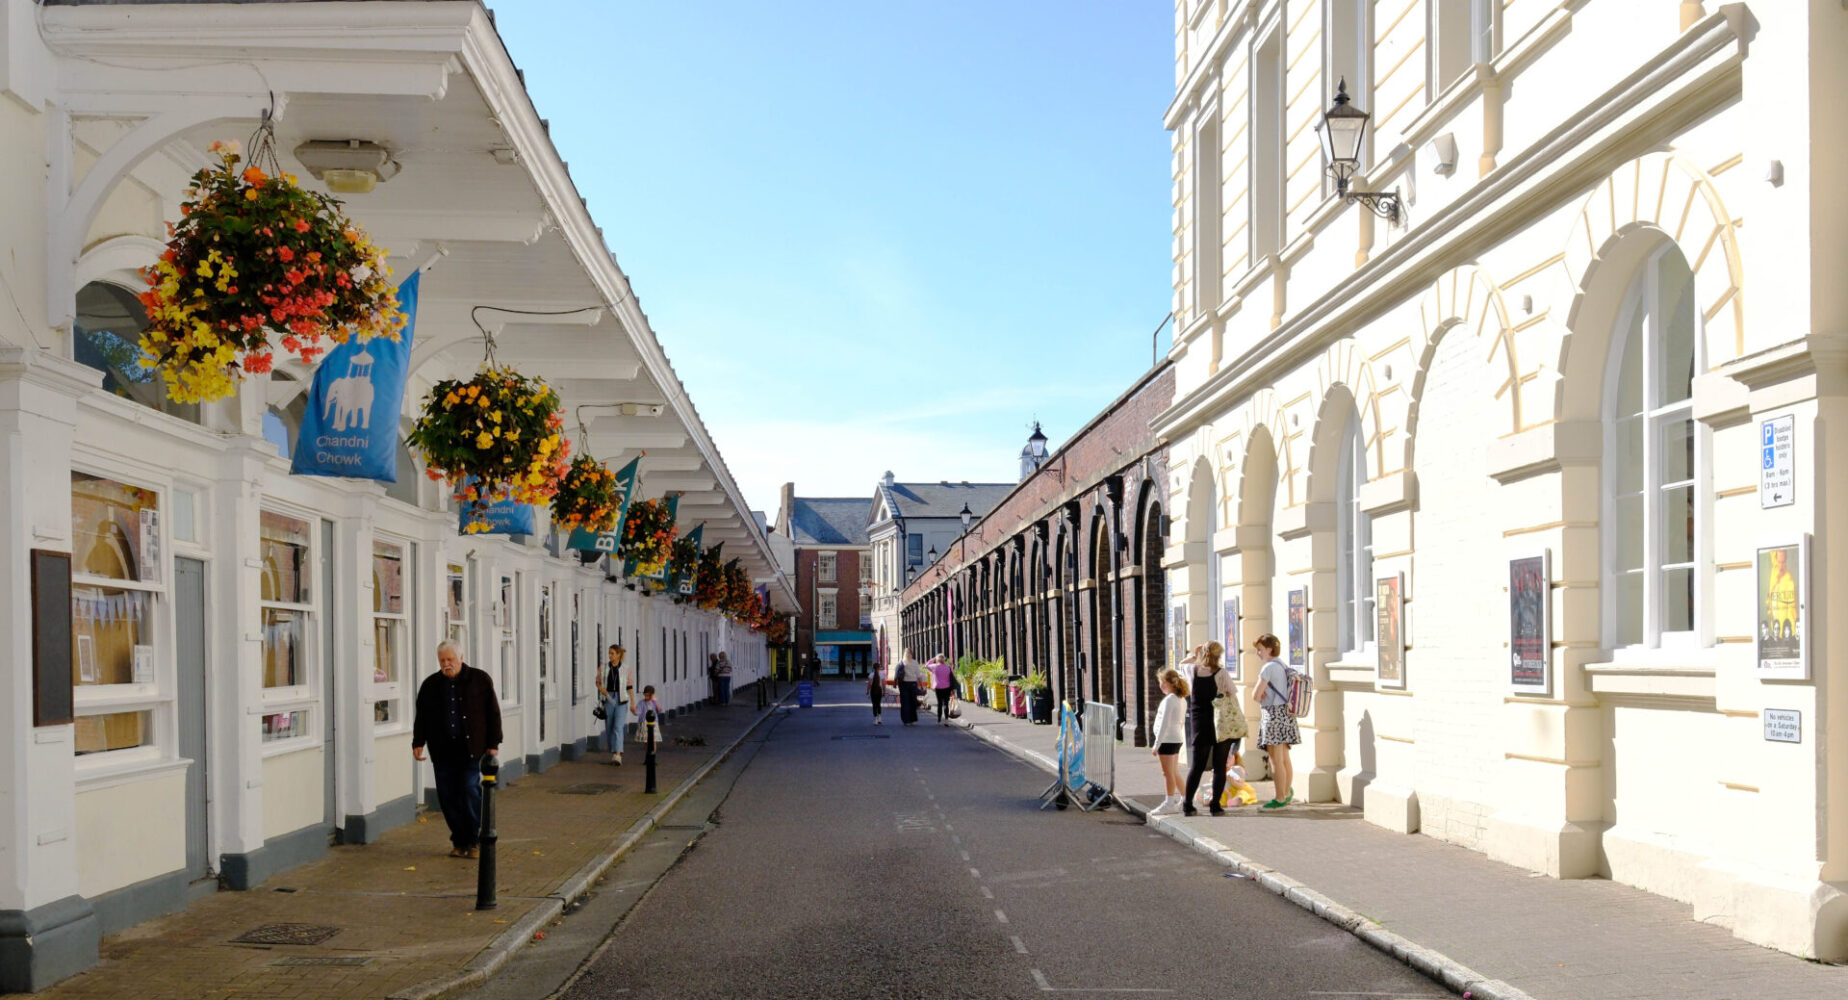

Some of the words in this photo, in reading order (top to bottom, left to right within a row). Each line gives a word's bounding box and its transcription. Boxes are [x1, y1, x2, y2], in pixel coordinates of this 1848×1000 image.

[316, 435, 369, 449] Chandni
[316, 451, 362, 466] Chowk
[595, 477, 630, 552] BLK
[1770, 712, 1776, 720] No
[1778, 721, 1797, 731] Saturday
